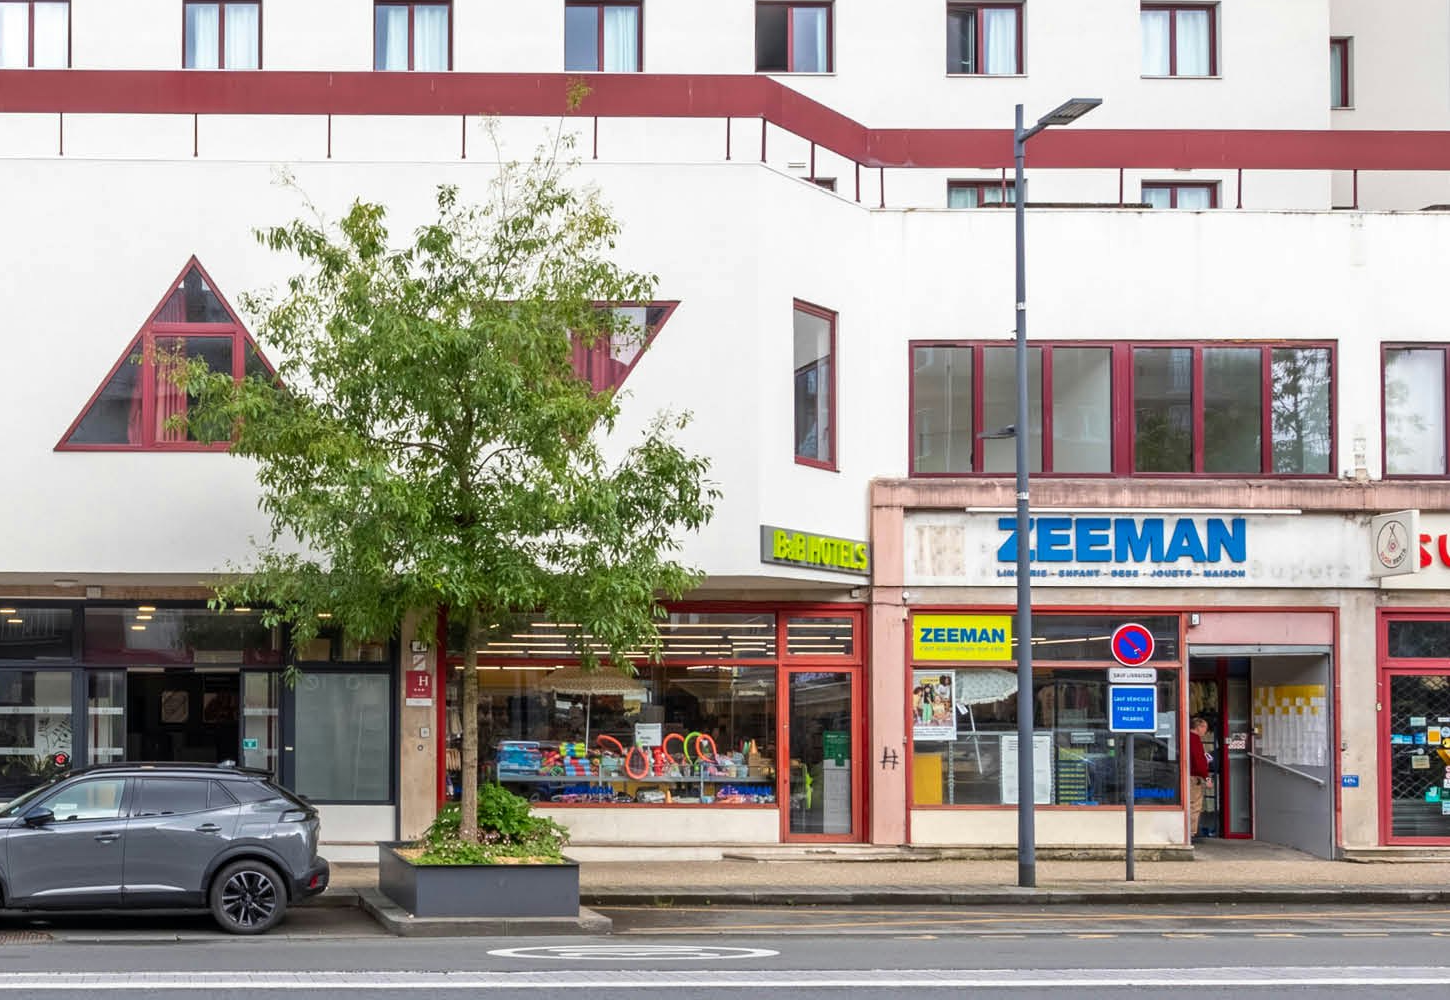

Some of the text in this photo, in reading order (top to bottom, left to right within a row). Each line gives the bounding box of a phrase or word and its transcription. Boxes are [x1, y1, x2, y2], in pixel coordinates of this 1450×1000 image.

[997, 517, 1247, 563] ZEEMAN
[773, 530, 869, 569] B&B HOTELS
[997, 569, 1047, 577] LINRIE
[1058, 569, 1100, 577] ENFANT
[1150, 569, 1193, 577] JOUETS
[1203, 569, 1246, 577] MAISON
[919, 627, 1005, 643] ZEEMAN
[418, 675, 429, 687] H
